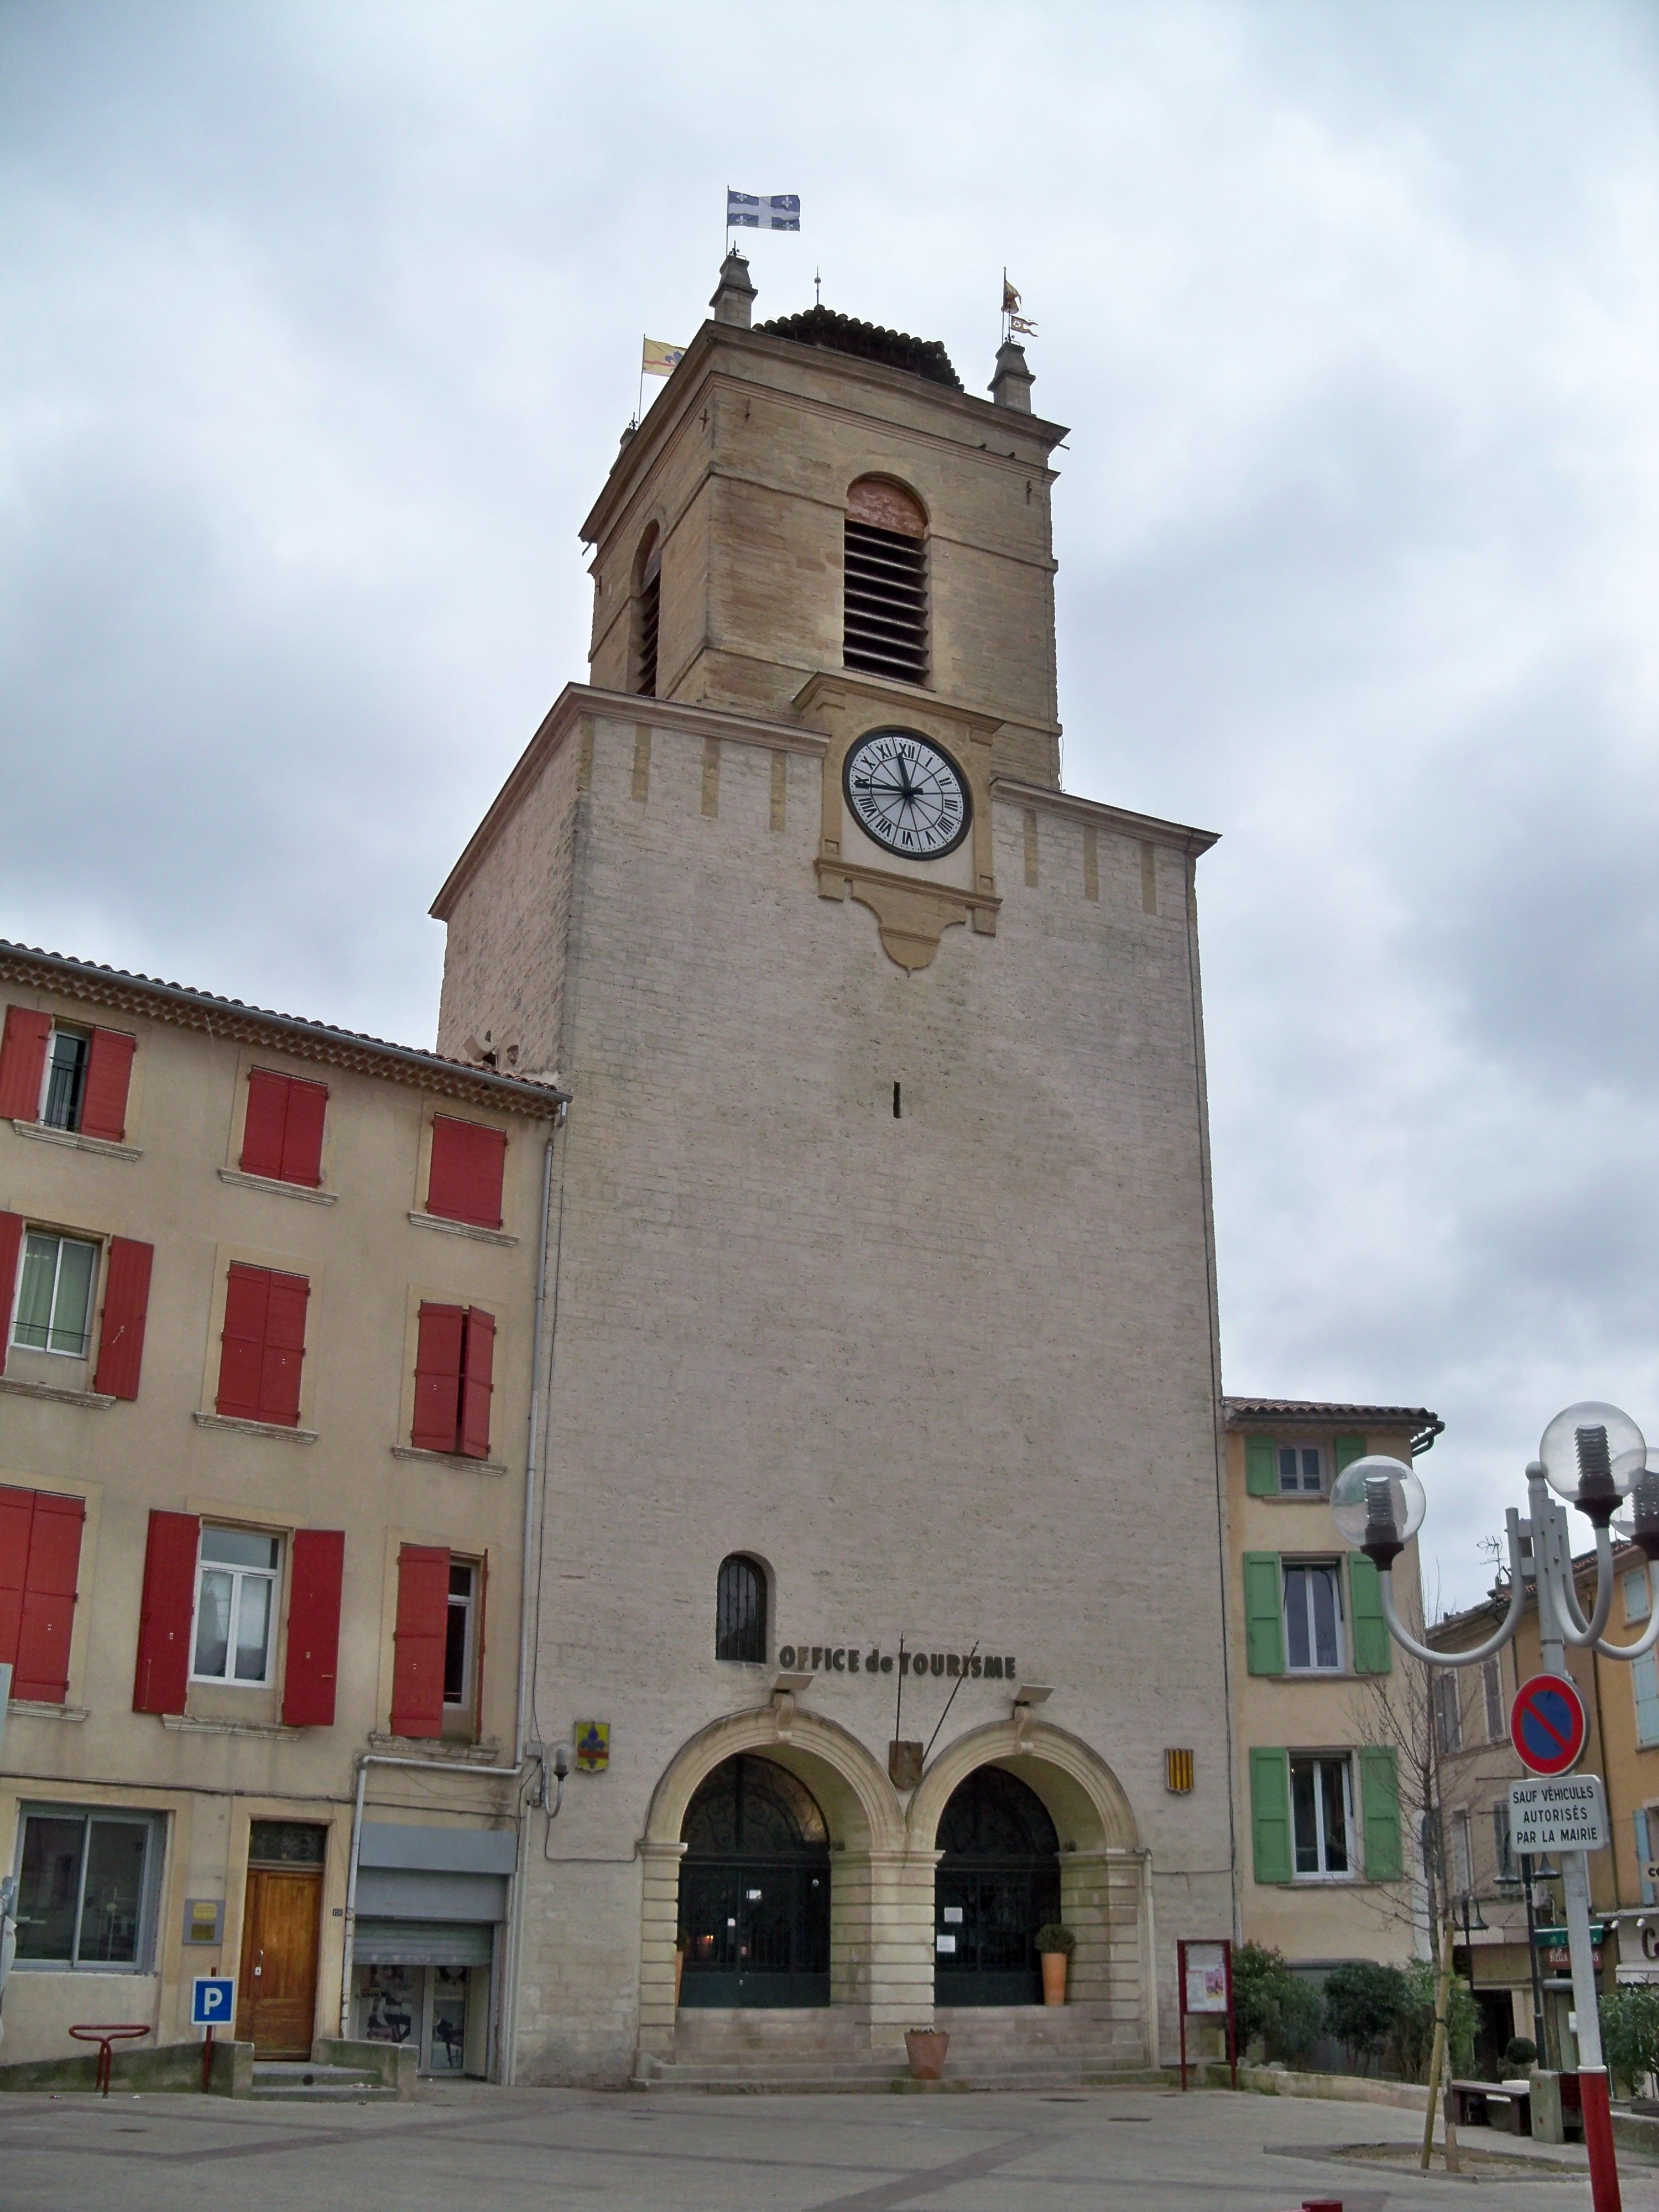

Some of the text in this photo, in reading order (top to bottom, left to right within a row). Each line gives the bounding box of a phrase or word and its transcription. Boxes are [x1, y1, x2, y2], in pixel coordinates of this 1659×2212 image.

[877, 743, 892, 759] XI
[898, 743, 914, 759] XII
[861, 755, 876, 770] X
[925, 757, 933, 768] I
[938, 777, 952, 786] II
[858, 798, 877, 818] VIII
[944, 799, 958, 812] III
[875, 818, 892, 837] VII
[937, 816, 954, 834] IIII
[902, 831, 914, 846] VI
[925, 831, 936, 846] V
[779, 1645, 1016, 1679] OFFICE de TOURISME
[1513, 1786, 1594, 1804] SAUF VÉHICULES
[1524, 1804, 1588, 1823] AUTORISÉS
[1516, 1827, 1598, 1844] PAR LA MAIRIE
[204, 1987, 222, 2015] P
